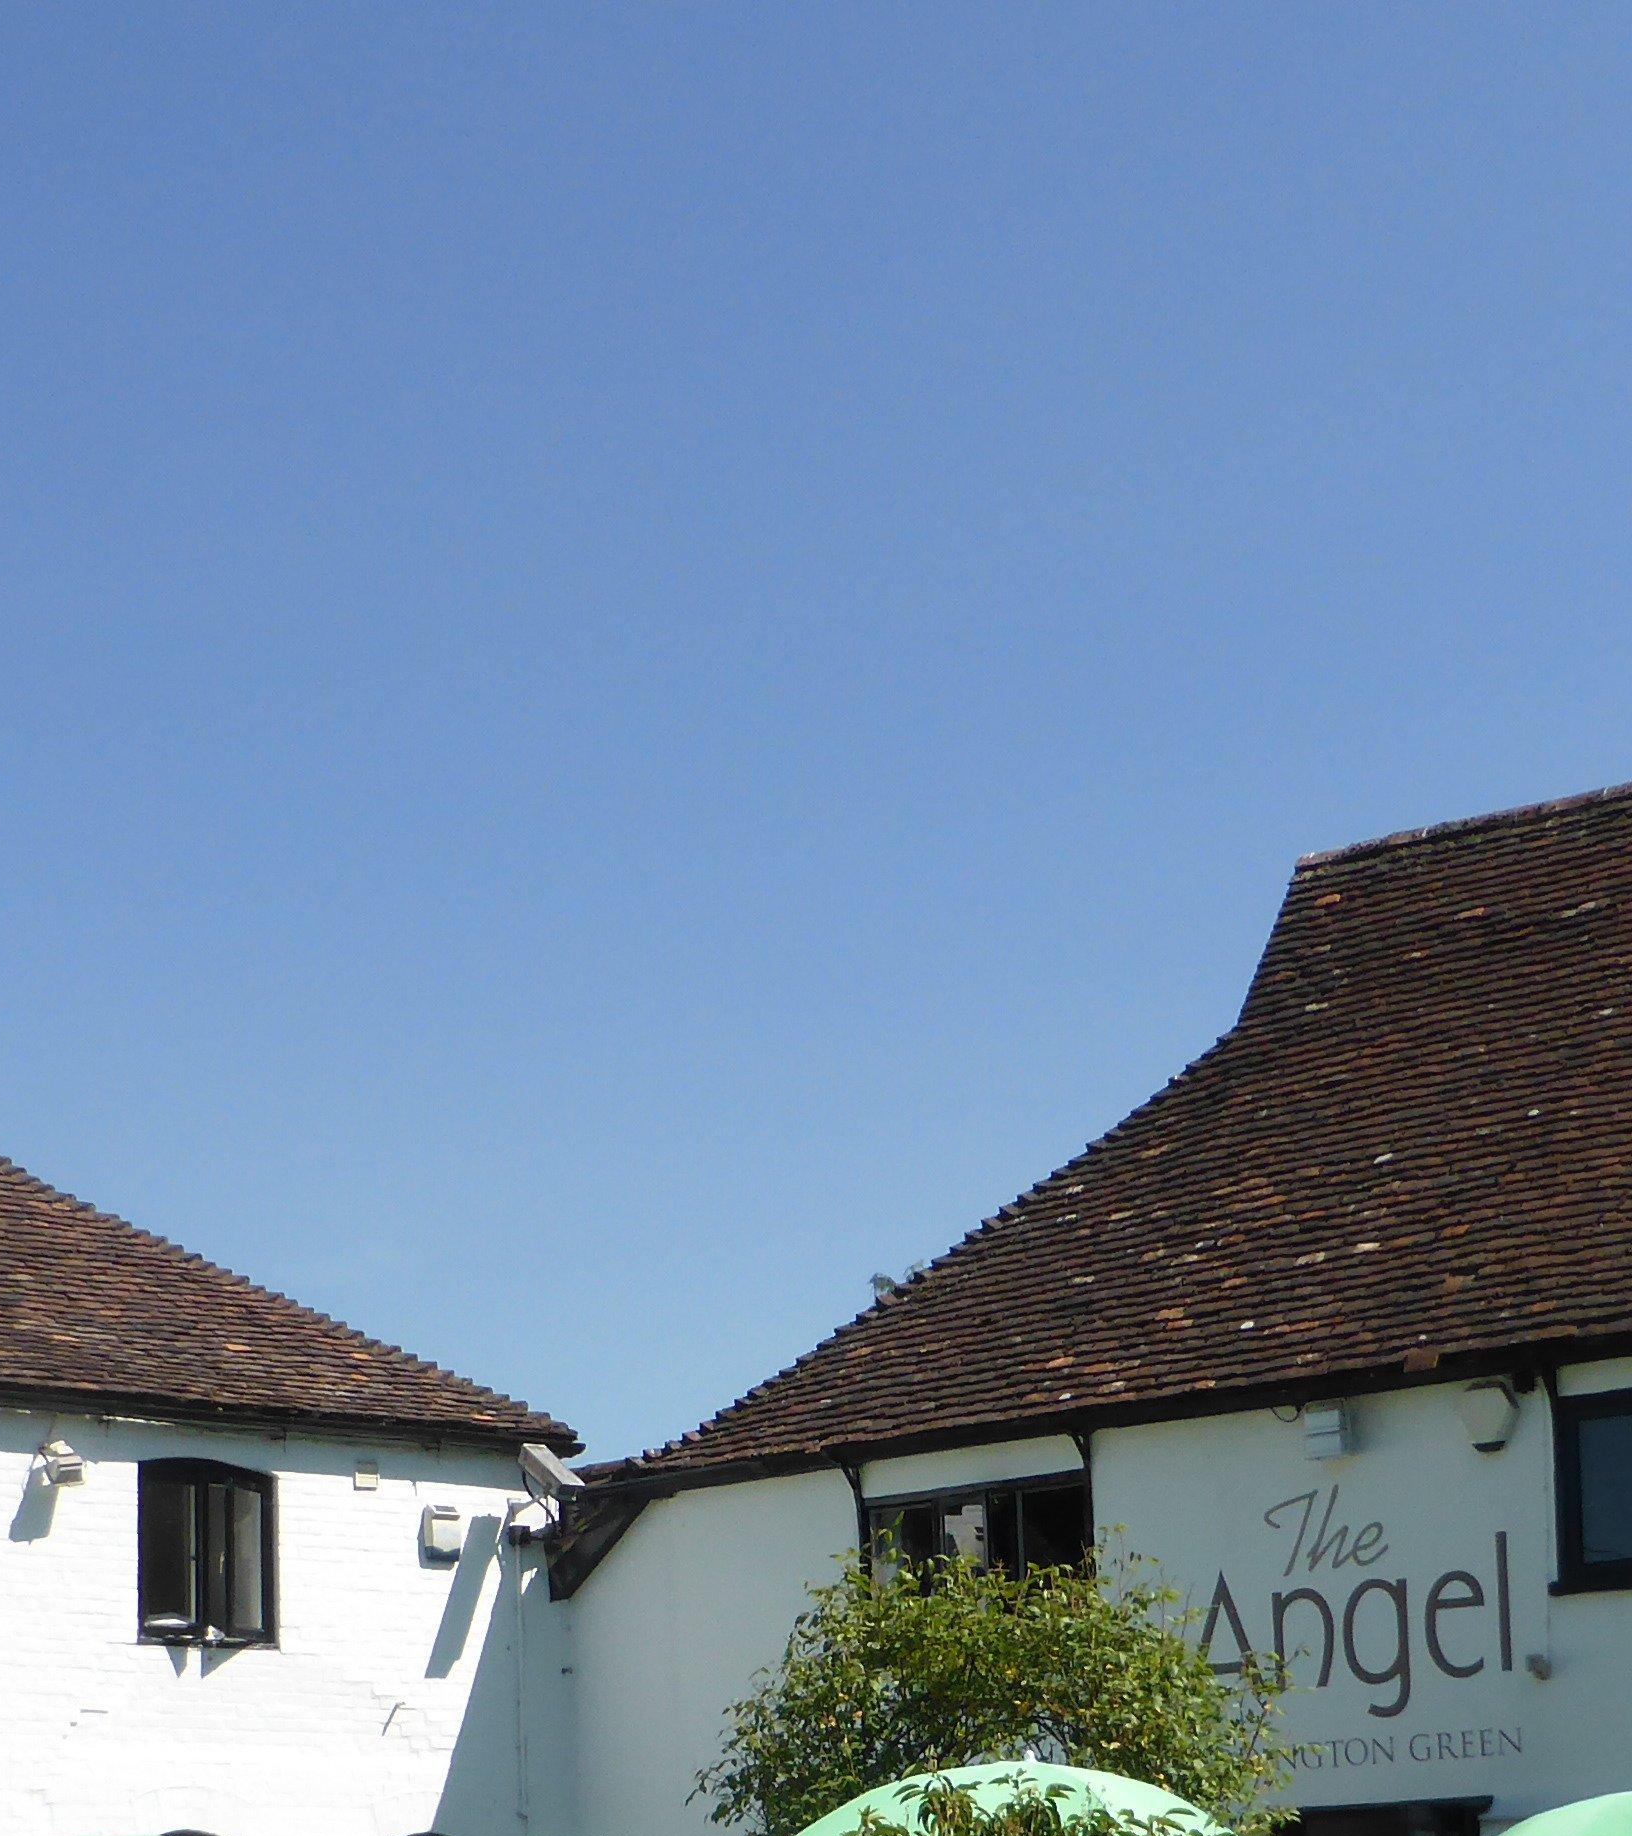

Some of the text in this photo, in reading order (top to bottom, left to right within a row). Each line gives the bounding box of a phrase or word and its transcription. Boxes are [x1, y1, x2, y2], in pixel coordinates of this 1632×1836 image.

[1263, 1483, 1389, 1577] The
[1200, 1530, 1513, 1719] Angel
[1277, 1726, 1523, 1770] NGTON GREEN
